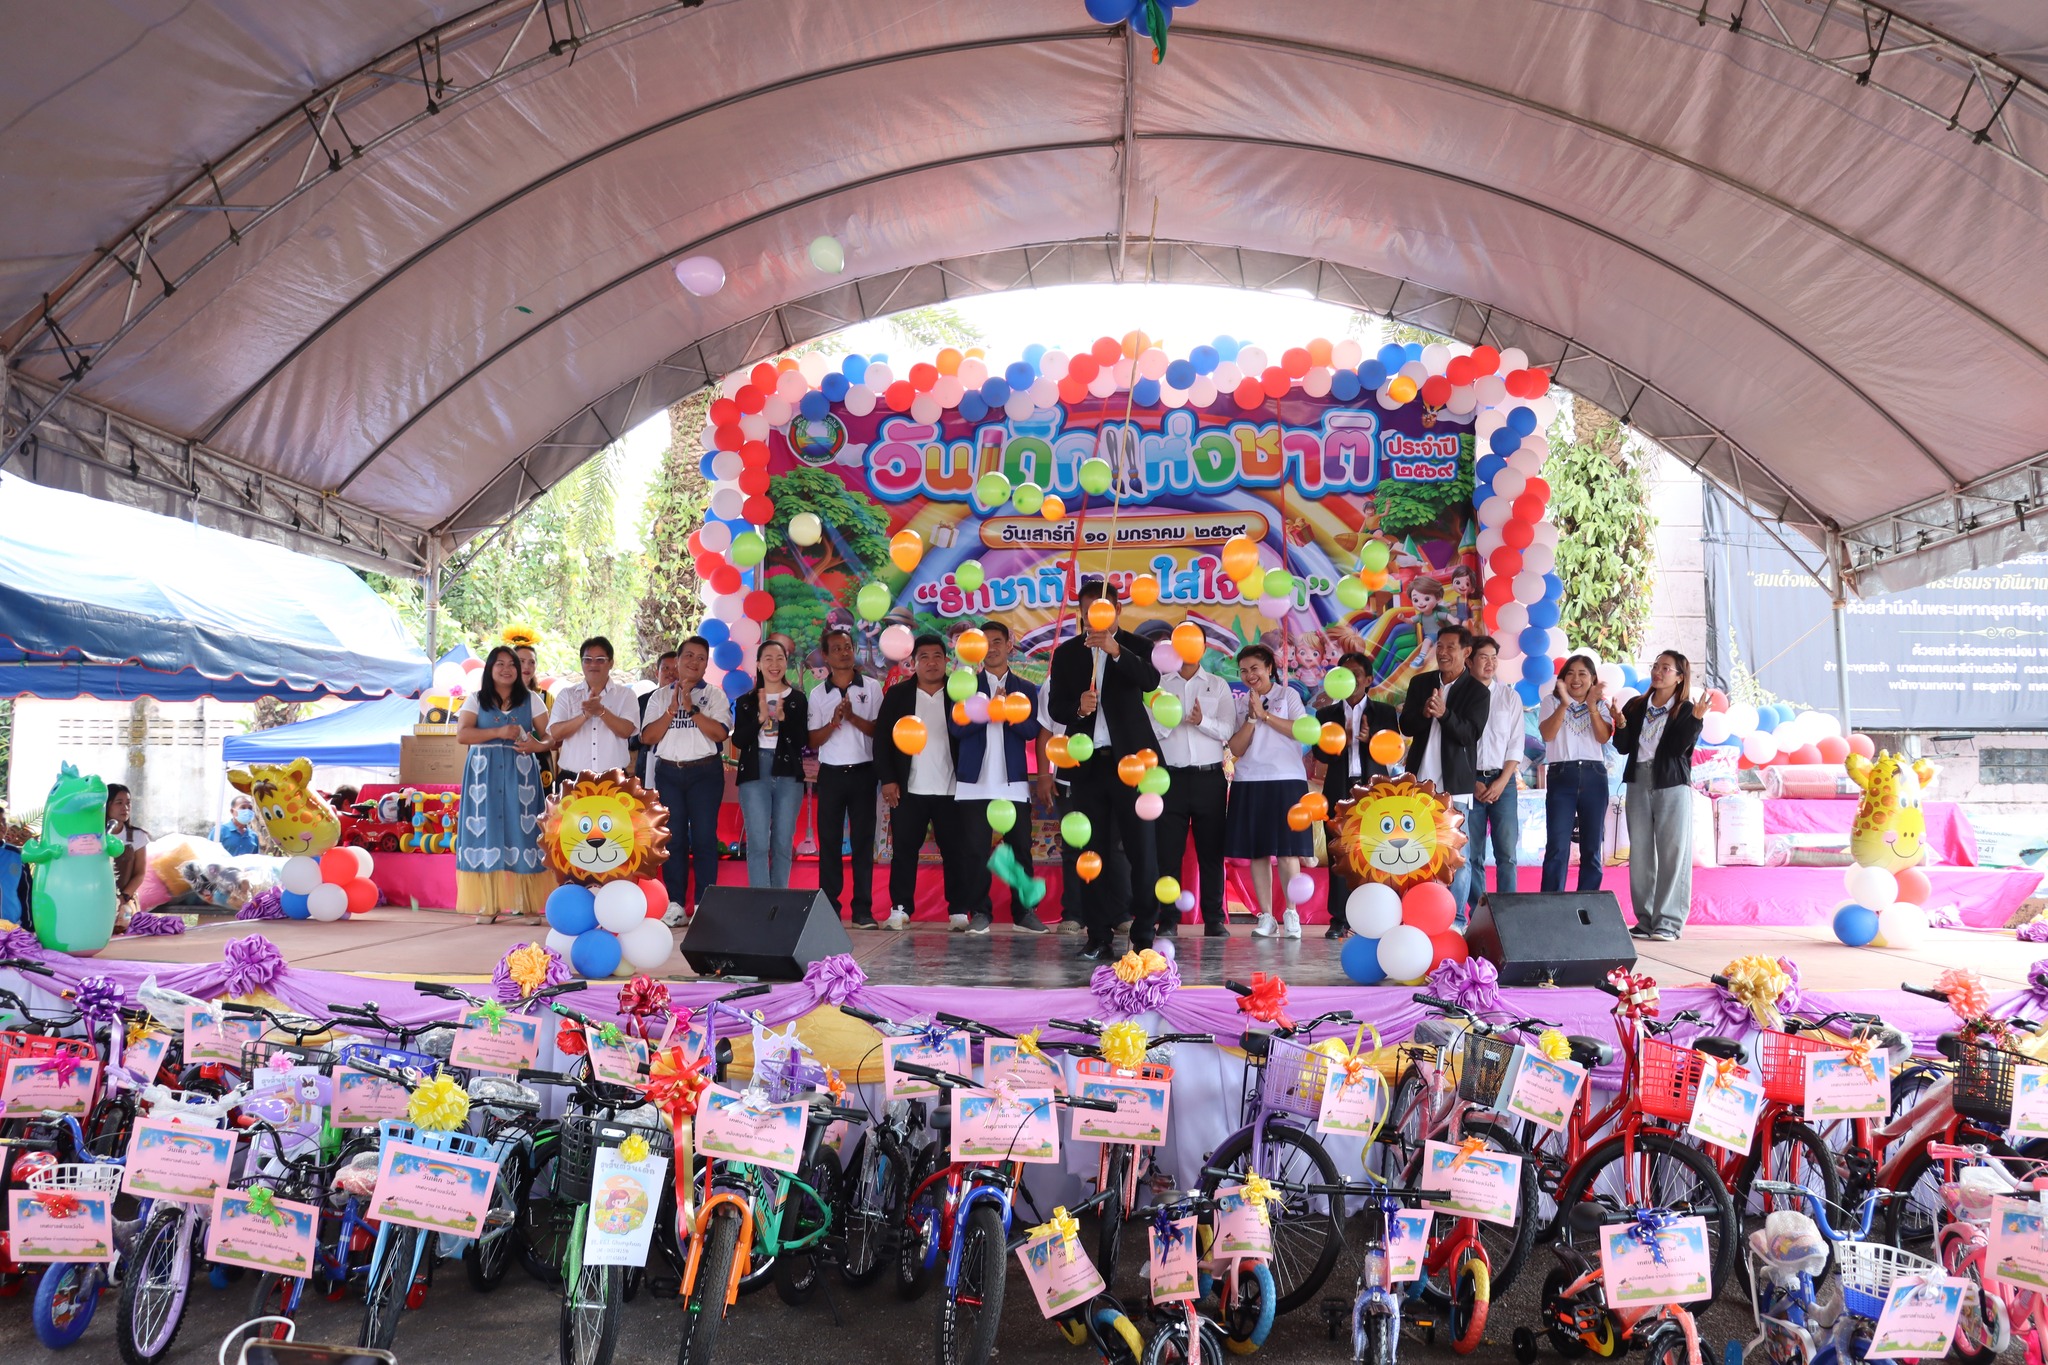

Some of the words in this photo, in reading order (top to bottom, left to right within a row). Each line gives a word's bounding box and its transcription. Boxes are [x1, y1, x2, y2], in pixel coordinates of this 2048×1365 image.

[1388, 435, 1457, 457] ประจำปี
[1394, 463, 1455, 479] ๒๕๖๙
[1002, 520, 1075, 542] วันเสาร์ที่
[1084, 531, 1107, 543] ๑๐
[1116, 525, 1185, 541] มกราคม
